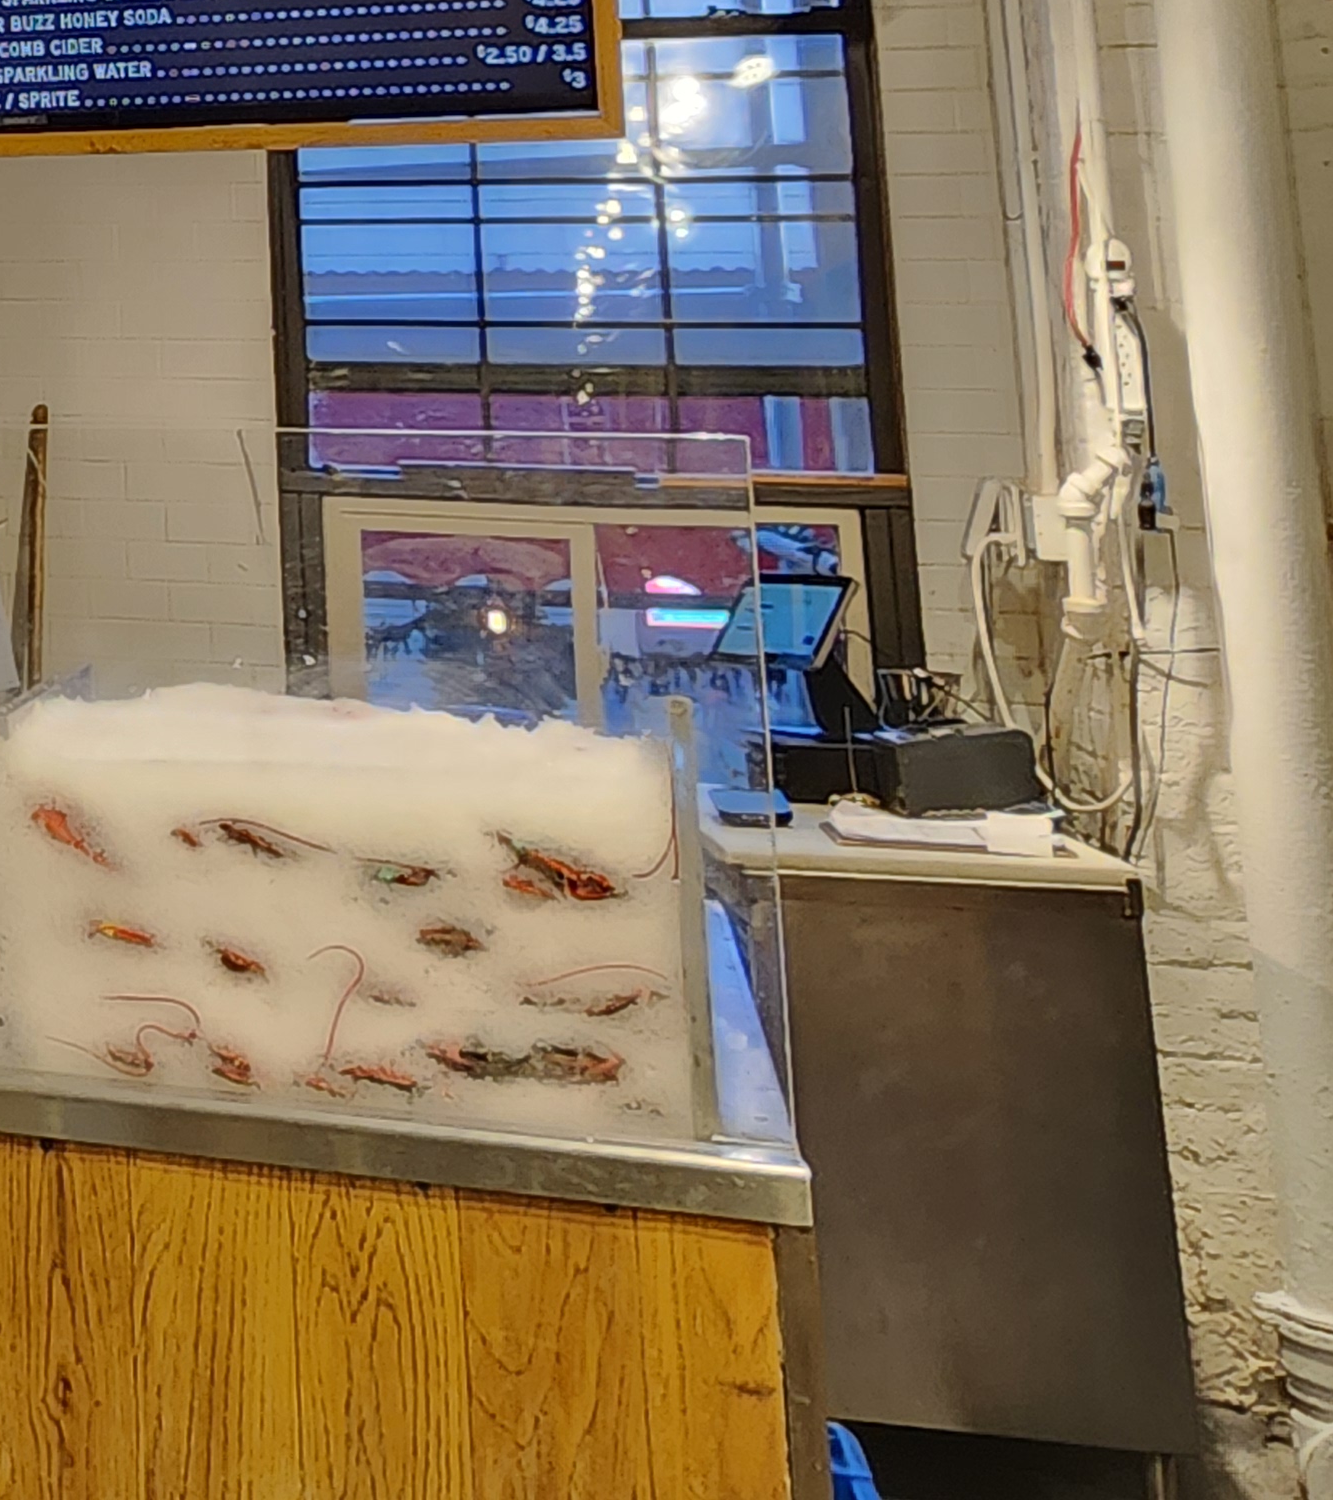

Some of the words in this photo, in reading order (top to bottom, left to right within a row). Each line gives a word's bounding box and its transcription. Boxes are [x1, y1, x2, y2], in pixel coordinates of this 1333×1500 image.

[11, 14, 55, 32] BUZZ
[60, 11, 119, 29] HONEY
[124, 8, 172, 25] SODA
[50, 38, 102, 55] CIDER
